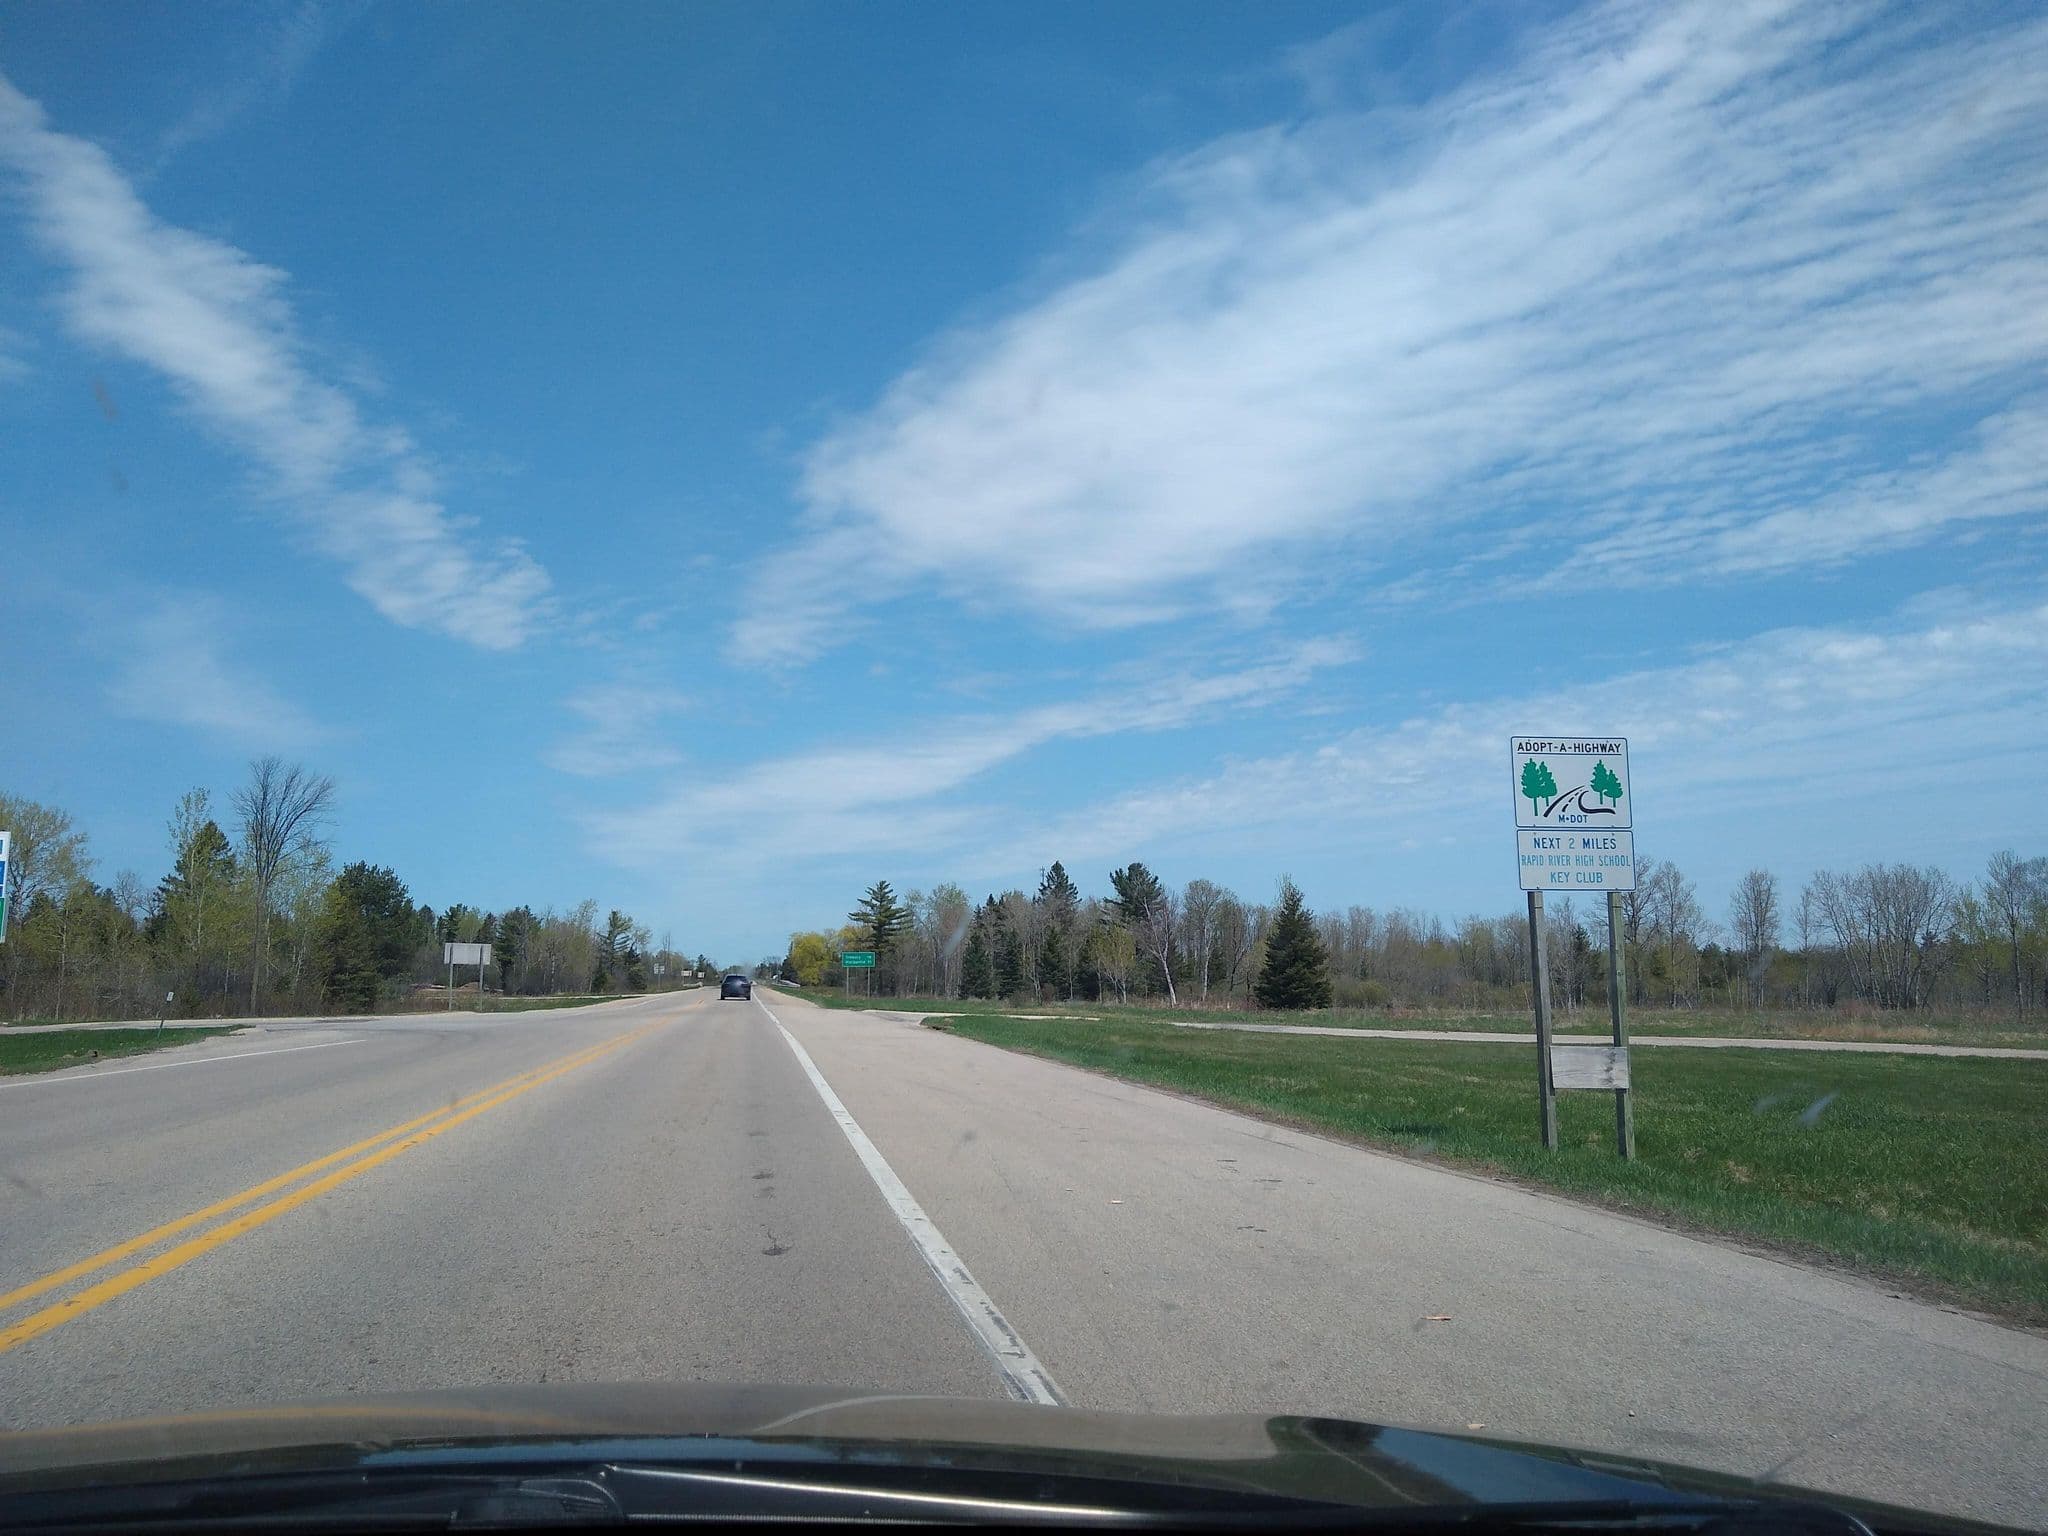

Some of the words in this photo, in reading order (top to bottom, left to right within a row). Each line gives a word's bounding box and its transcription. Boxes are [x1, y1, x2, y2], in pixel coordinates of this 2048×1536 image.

[1517, 742, 1621, 753] ADOPT-A-HIGHWAY
[1534, 838, 1561, 849] NEXT
[1569, 838, 1575, 849] 2
[1583, 838, 1617, 849] MILES
[1521, 855, 1544, 866] RAPID
[1549, 855, 1571, 866] RIVER
[1576, 855, 1594, 866] HIGH
[1599, 855, 1631, 867] SCHOOL
[1551, 872, 1570, 883] KEY
[1576, 872, 1603, 883] CLUB
